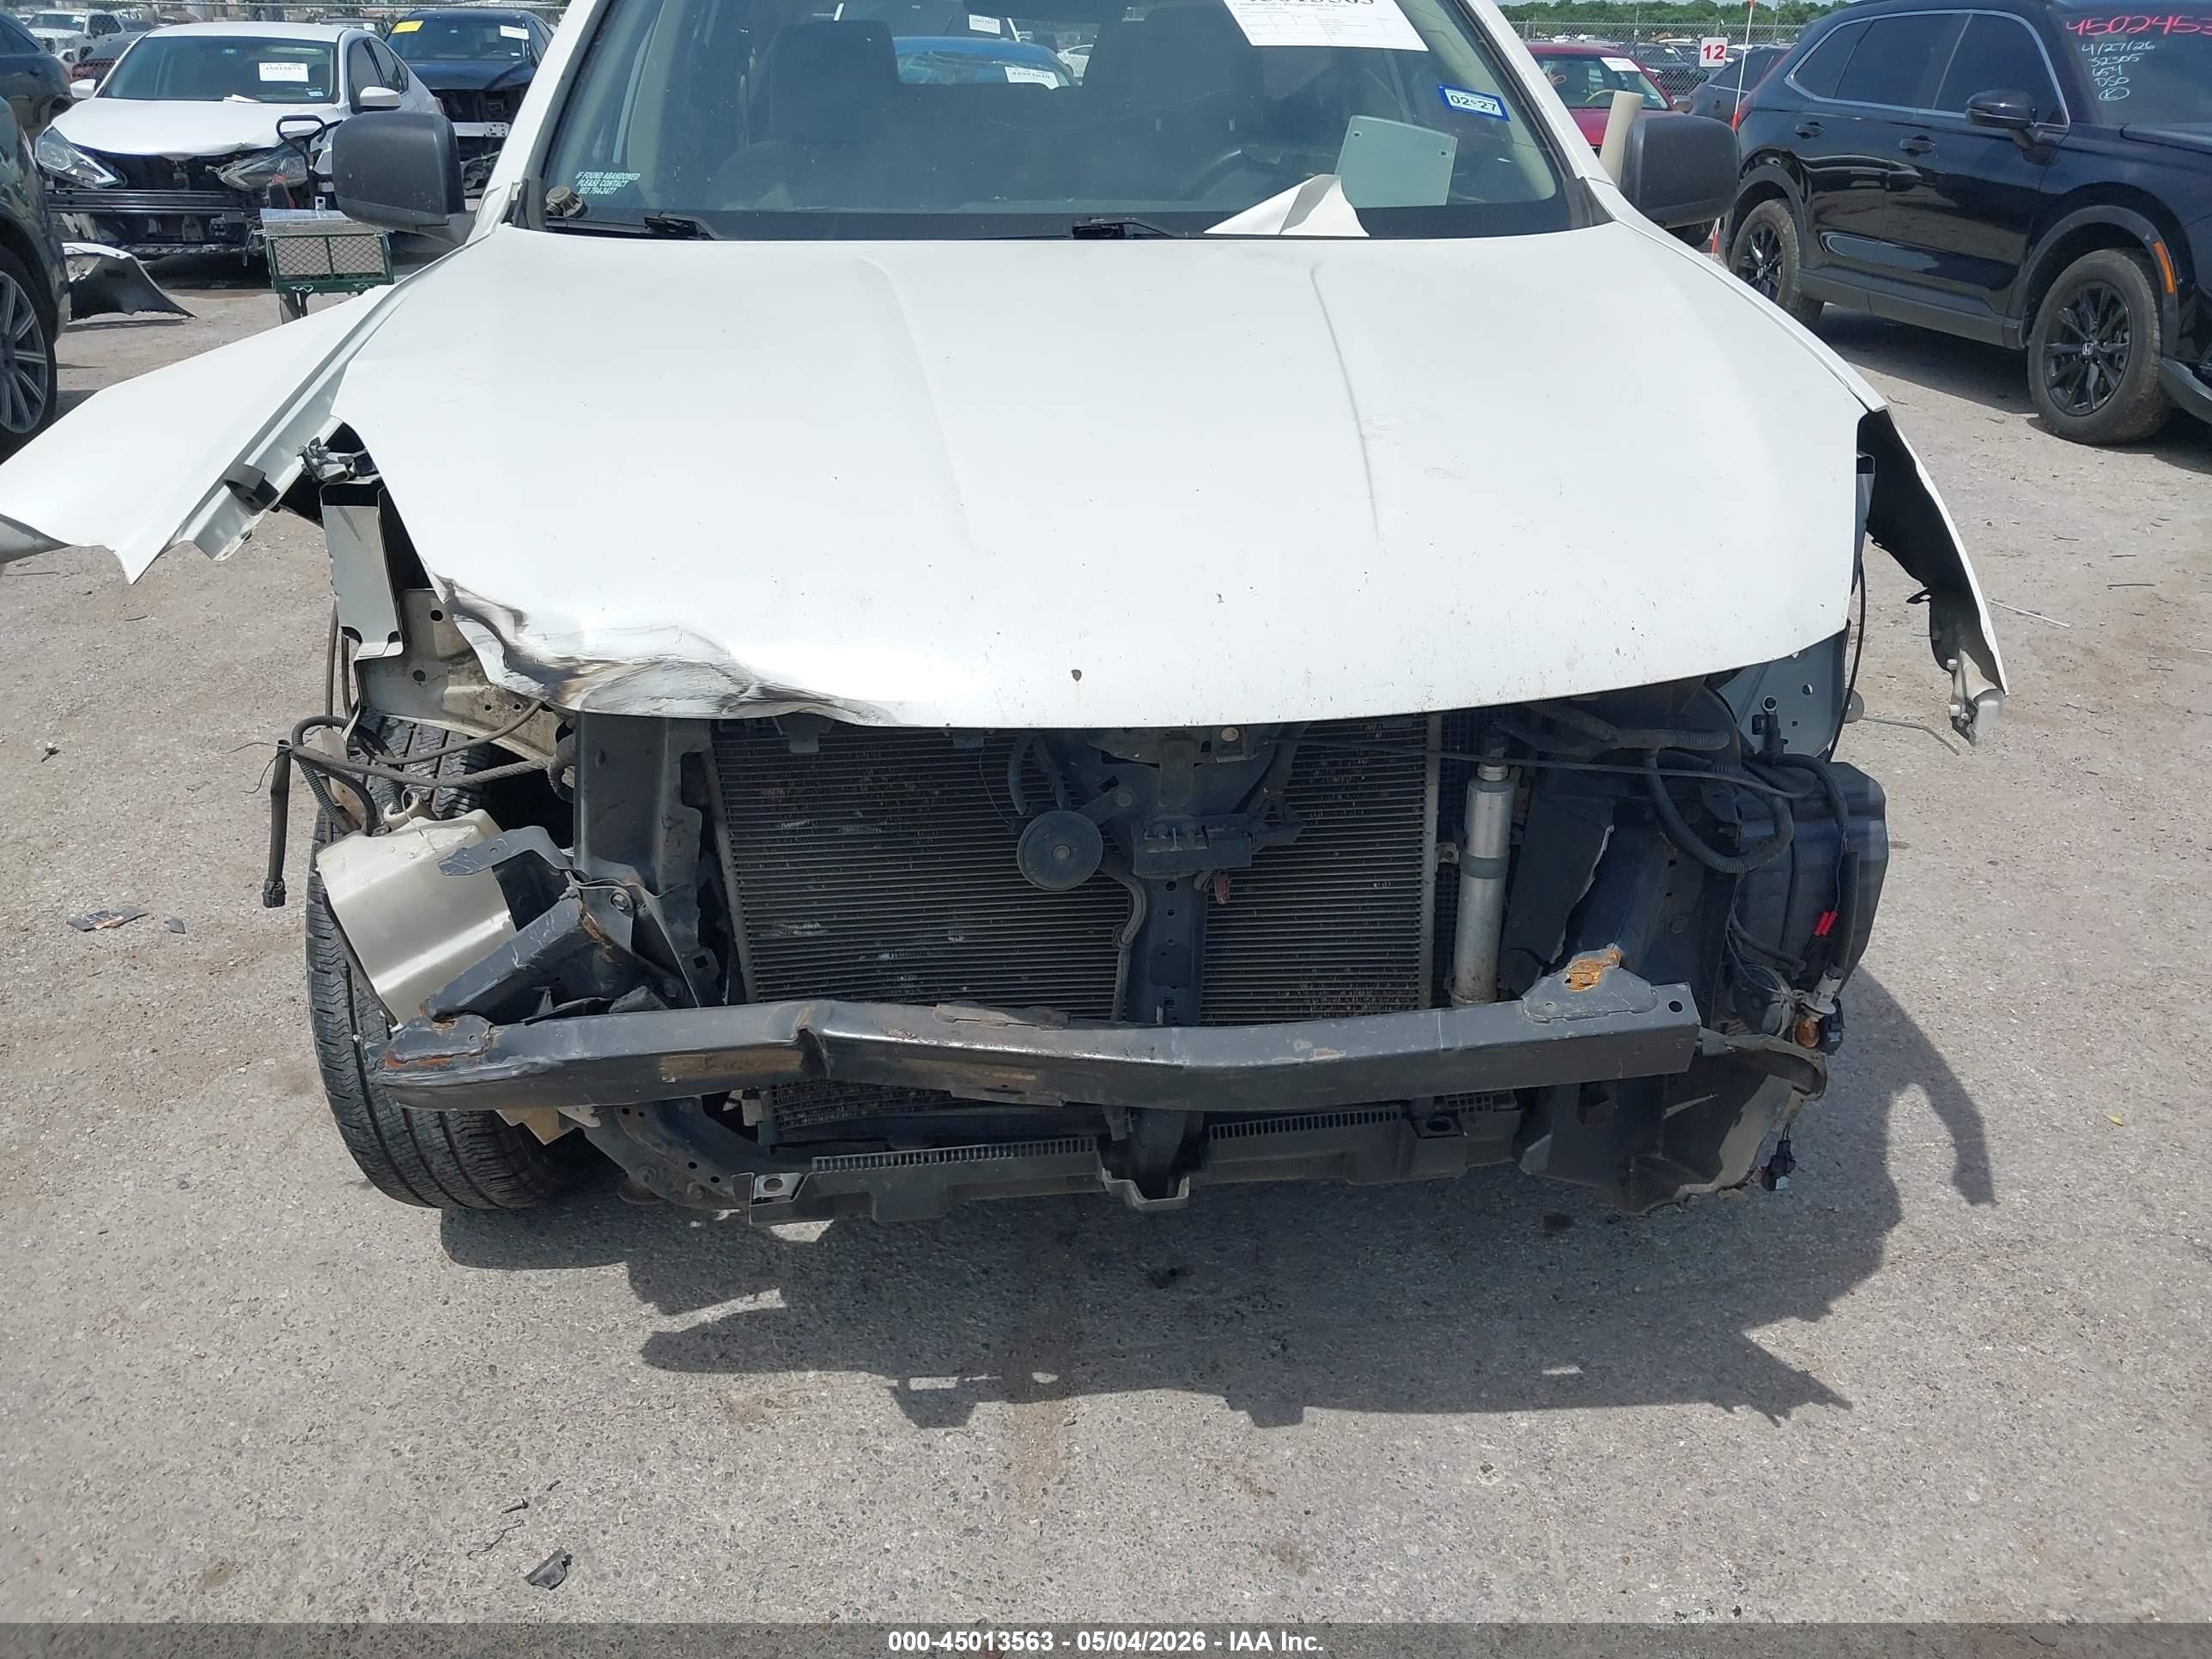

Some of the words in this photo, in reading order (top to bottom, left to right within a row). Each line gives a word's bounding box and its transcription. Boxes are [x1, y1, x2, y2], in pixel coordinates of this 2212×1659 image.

[1703, 44, 1725, 60] 12
[2081, 40, 2157, 55] 4/27/26
[1450, 94, 1472, 106] 02
[1478, 100, 1497, 112] 27
[576, 179, 602, 187] PLEASE
[599, 179, 629, 188] CONTACT
[603, 172, 641, 180] ABANDONED
